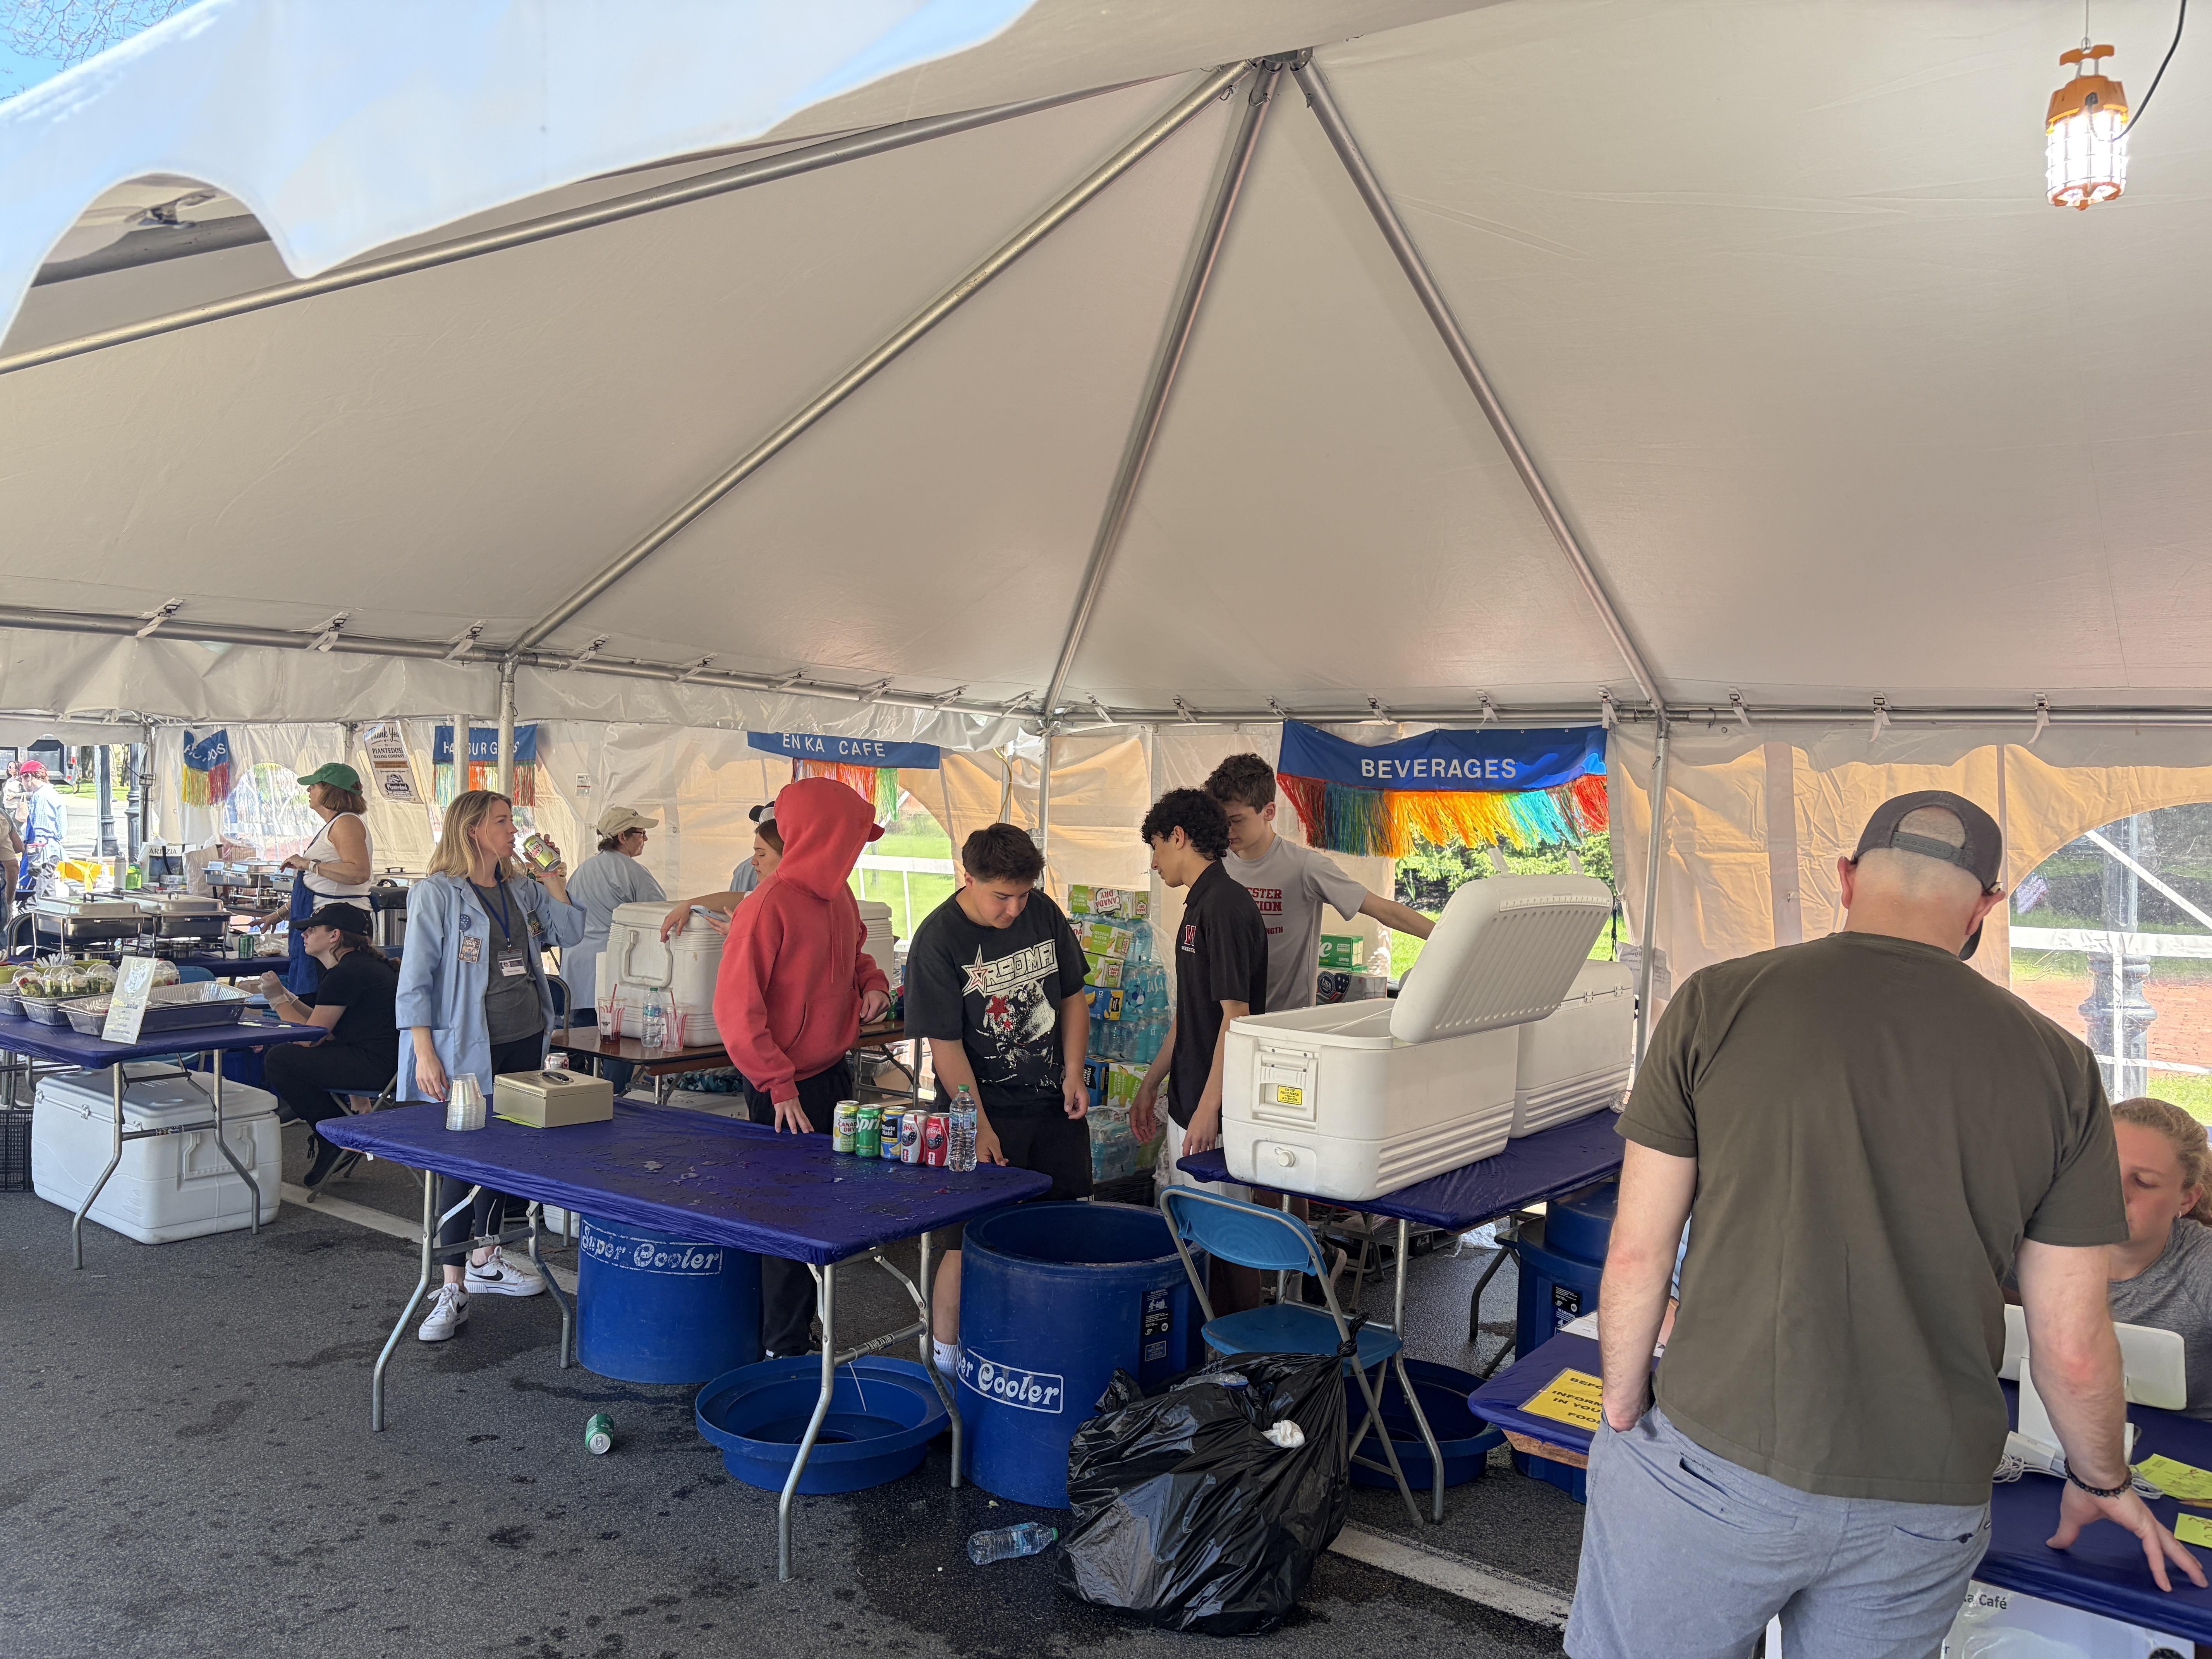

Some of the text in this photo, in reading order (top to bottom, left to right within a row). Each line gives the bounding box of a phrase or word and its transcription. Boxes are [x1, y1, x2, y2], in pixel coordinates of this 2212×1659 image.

[368, 727, 400, 742] Thank You
[783, 733, 885, 757] ENKA CAFE
[1361, 758, 1516, 778] BEVERAGES
[1101, 889, 1114, 898] DRY
[1095, 896, 1121, 908] CANADA
[1266, 926, 1283, 934] NGTH
[1322, 978, 1331, 989] USA
[856, 1114, 882, 1132] Spri
[582, 1225, 720, 1269] Super Cooler
[1558, 1308, 1576, 1319] WARNING
[957, 1350, 1060, 1405] per Cooler
[1570, 1377, 1603, 1389] BEFO
[1552, 1390, 1602, 1407] INFORM
[1979, 1594, 2007, 1609] Café
